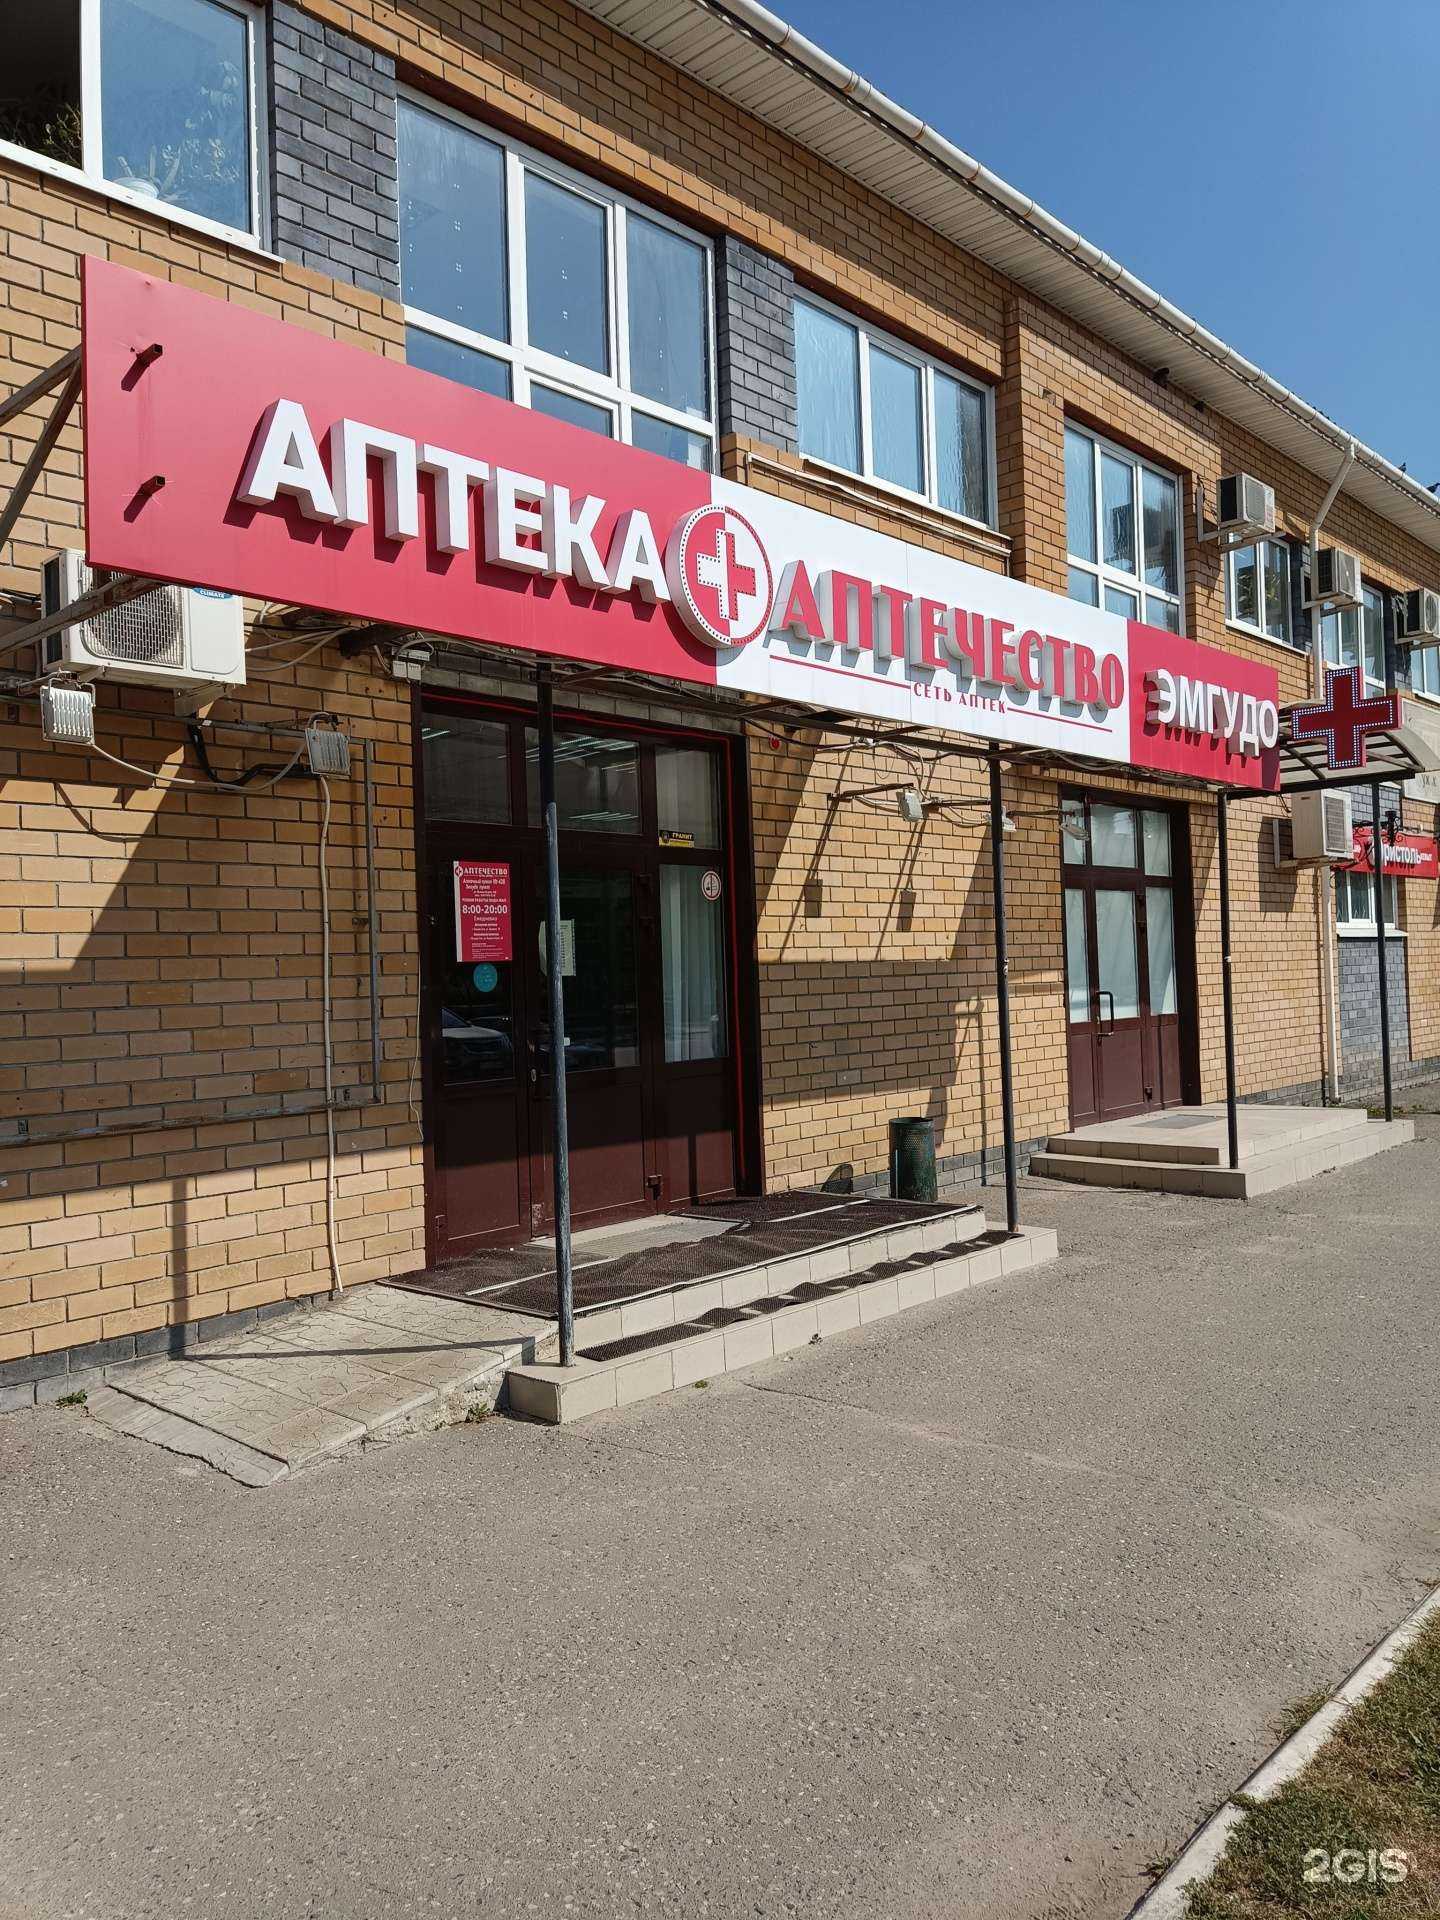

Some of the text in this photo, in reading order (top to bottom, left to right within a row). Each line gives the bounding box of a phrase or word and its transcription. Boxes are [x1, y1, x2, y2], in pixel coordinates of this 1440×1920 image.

[237, 398, 670, 604] АПТЕКА
[771, 560, 1125, 709] АПТЕЧЕСТВО
[913, 682, 1006, 714] СЕТЬ АПТЕК
[1145, 668, 1279, 757] ЭМГУДО
[463, 867, 508, 876] АПТЕЧЕСТВО
[462, 904, 508, 914] 8:00-20:00
